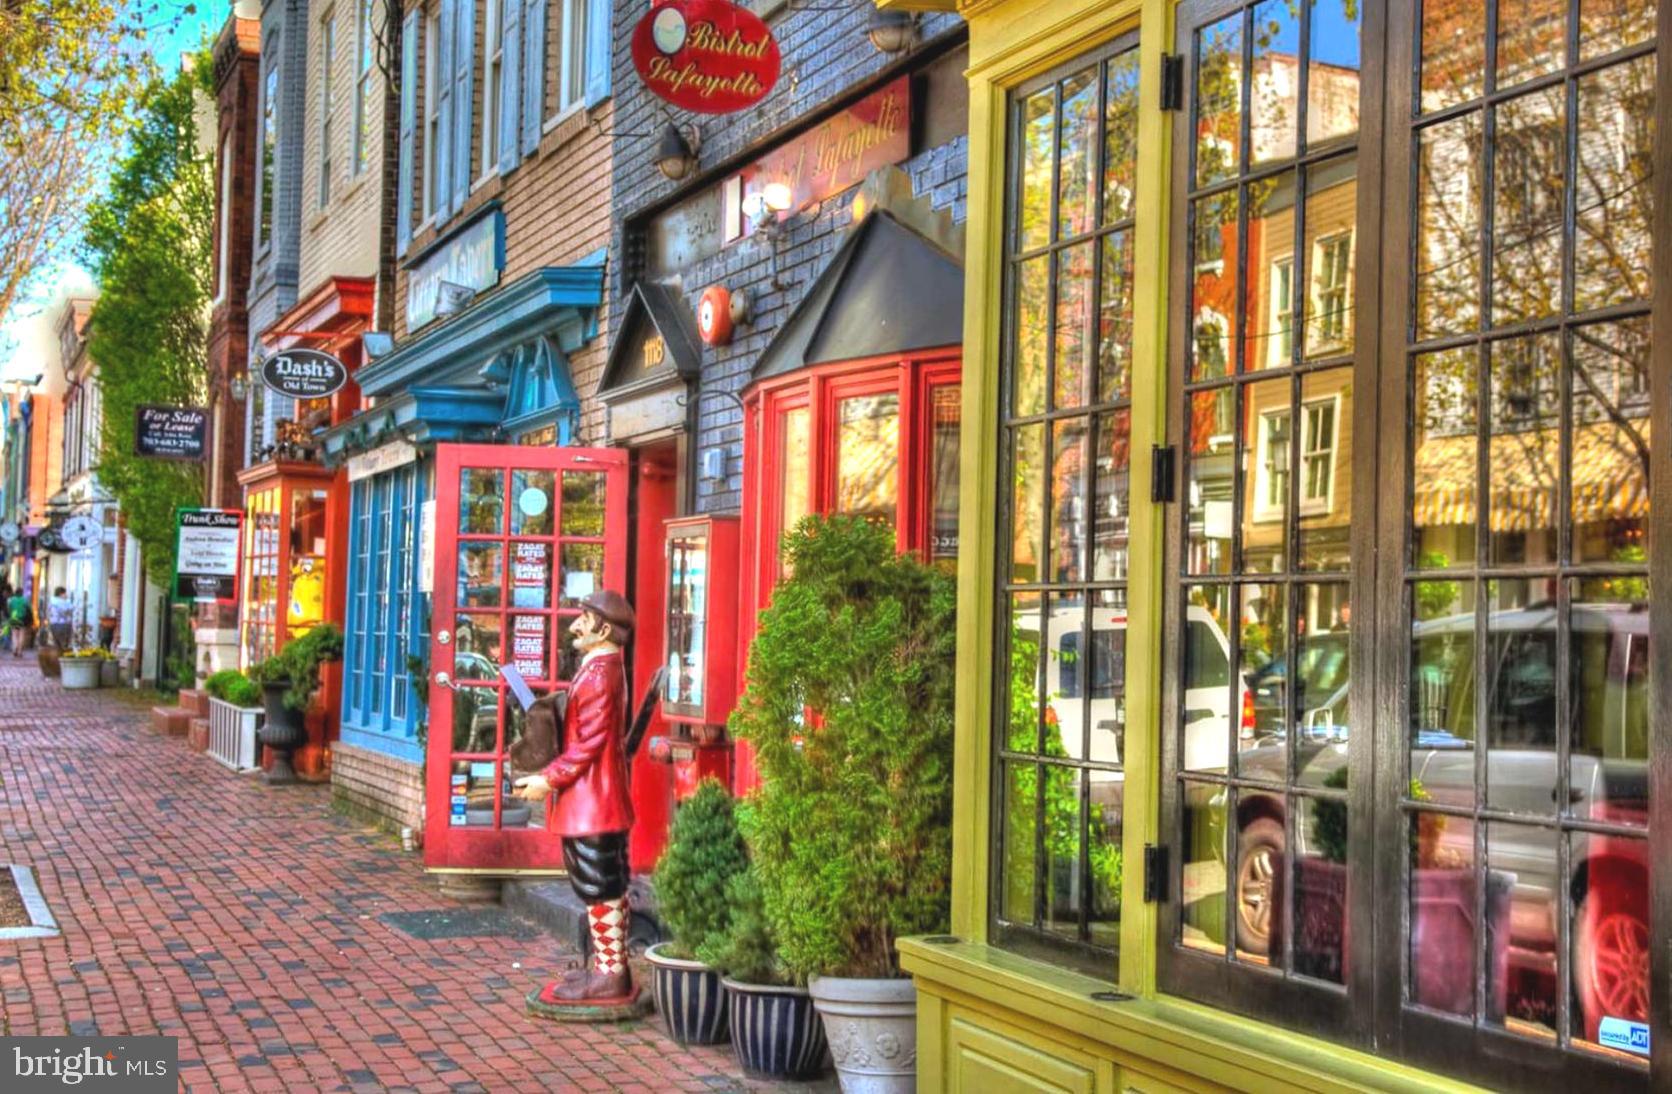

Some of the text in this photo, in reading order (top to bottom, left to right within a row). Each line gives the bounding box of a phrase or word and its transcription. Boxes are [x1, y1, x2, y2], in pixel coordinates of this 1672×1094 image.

[685, 21, 769, 58] Bistrot
[649, 55, 763, 97] Lafayette
[276, 356, 335, 378] Dash's
[283, 381, 300, 390] Old
[143, 409, 203, 424] For Sale
[164, 422, 195, 432] Lease
[182, 513, 238, 525] Trunk Show
[515, 571, 544, 579] RATED
[513, 645, 542, 653] RATED
[1631, 1030, 1648, 1046] ADT
